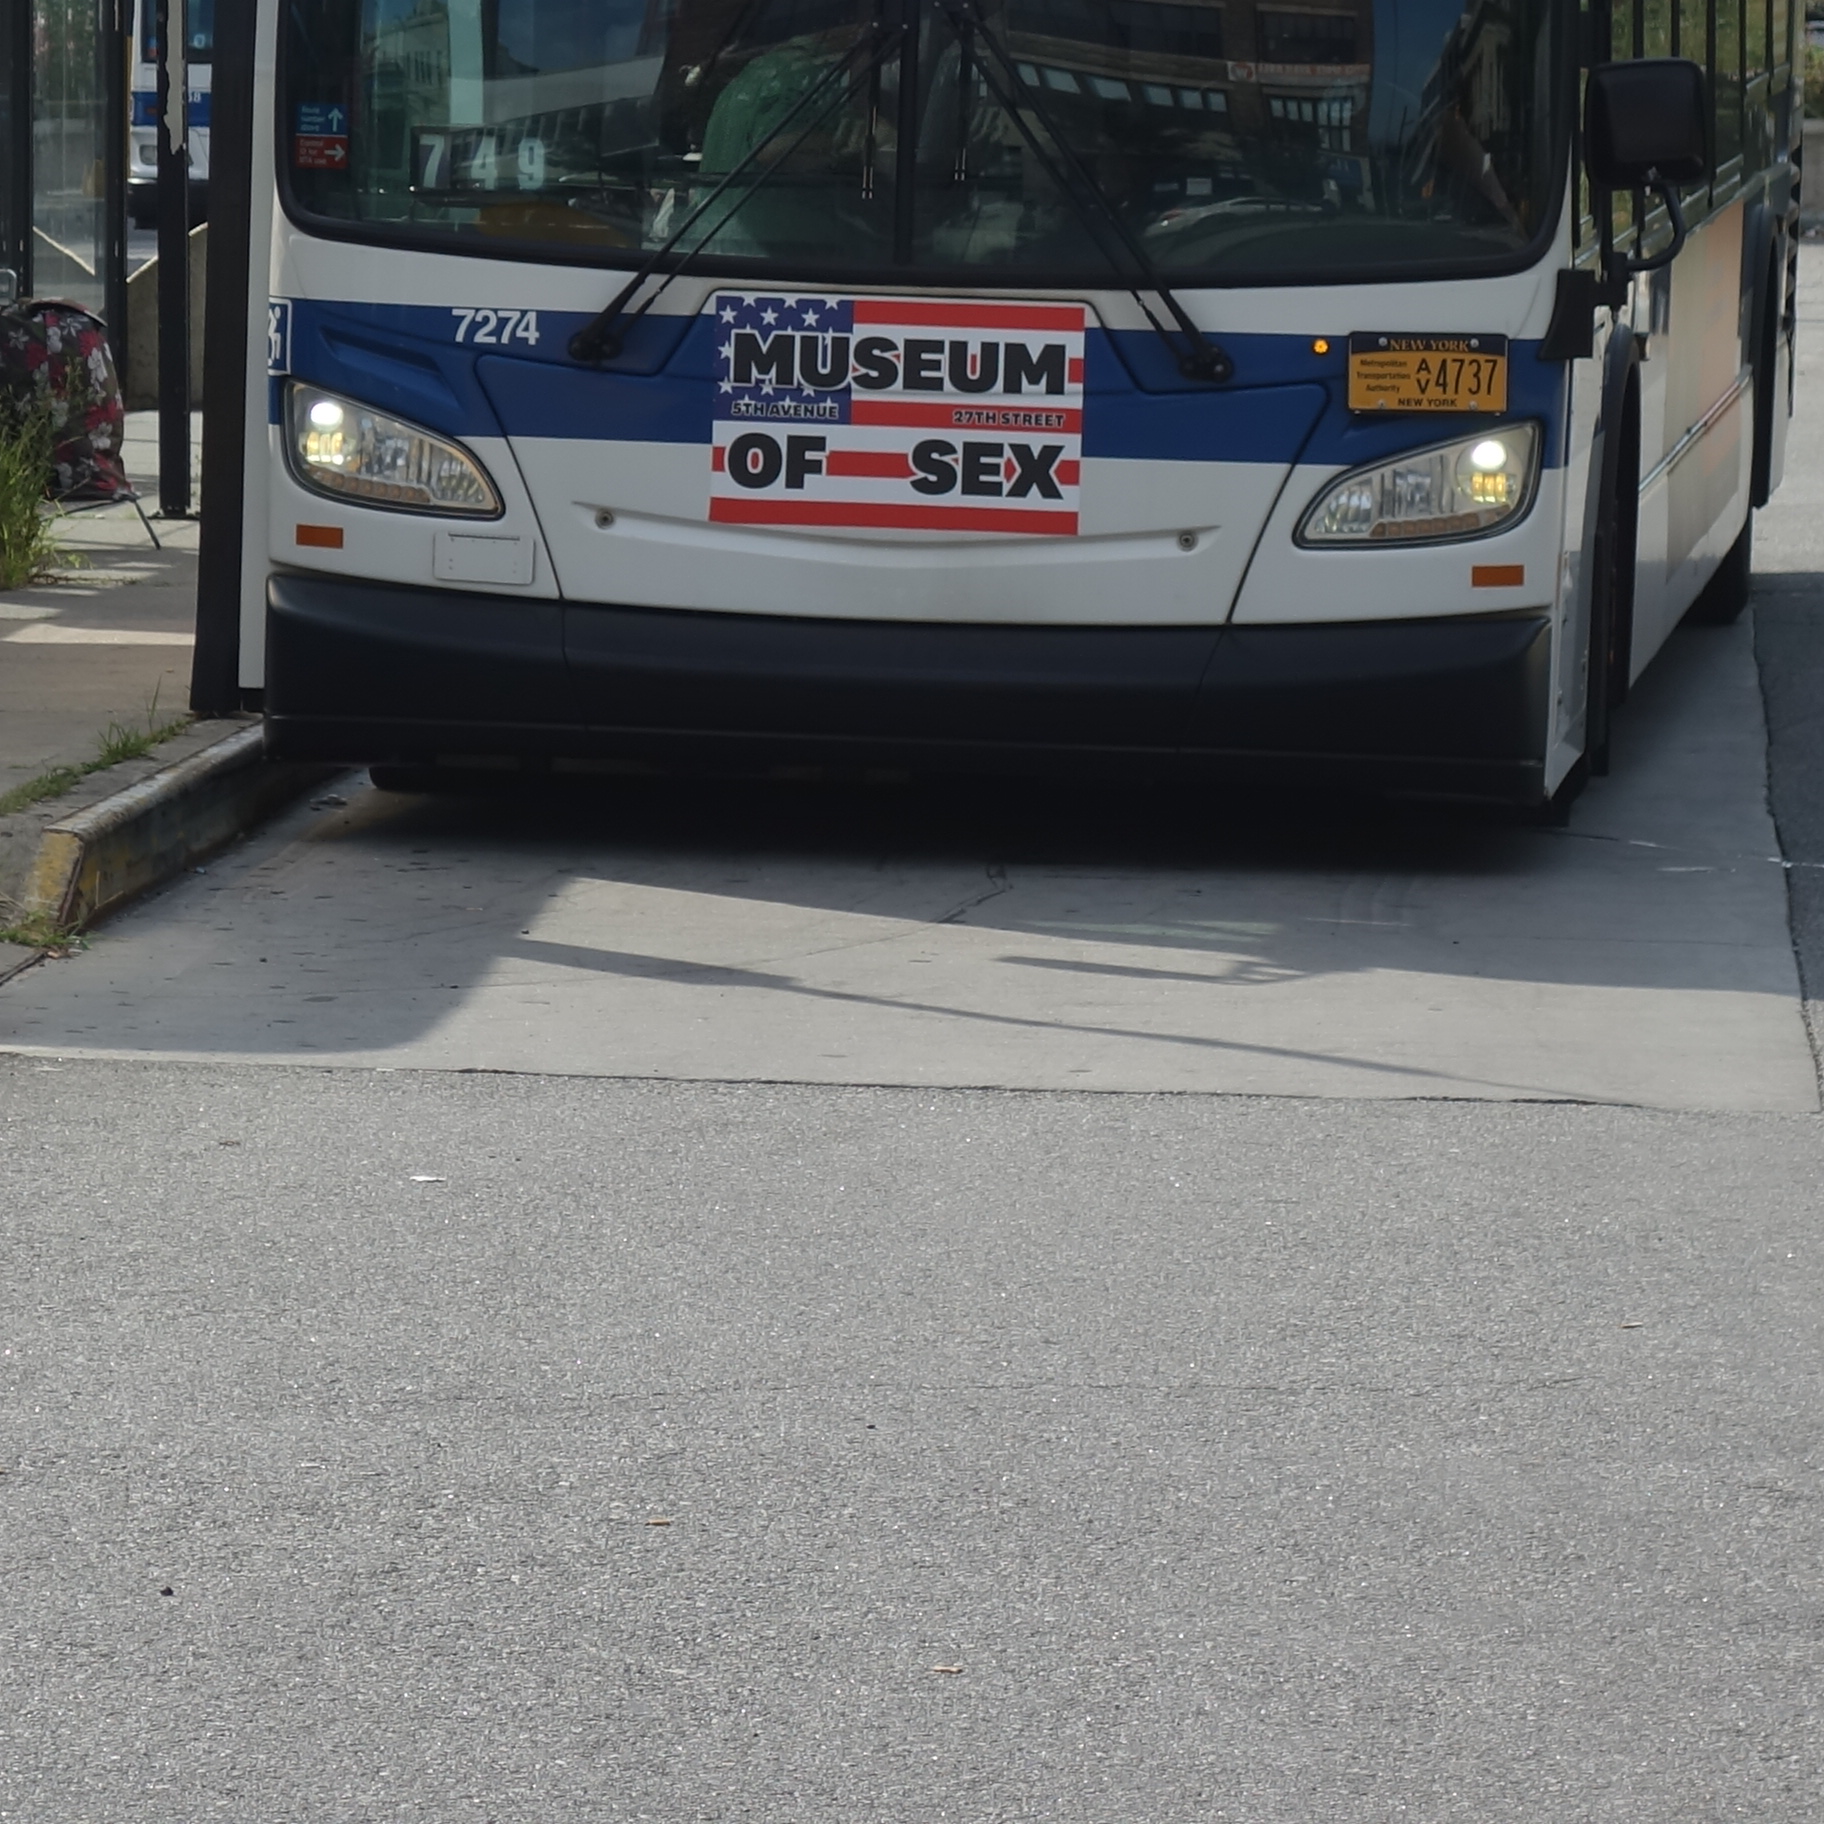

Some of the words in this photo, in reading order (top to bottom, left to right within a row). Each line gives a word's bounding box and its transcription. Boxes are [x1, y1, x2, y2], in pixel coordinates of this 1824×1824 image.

[451, 308, 540, 345] 7274
[730, 331, 1067, 397] MUSEUM
[1389, 338, 1427, 352] NEW
[1430, 338, 1469, 353] YORK
[1434, 358, 1498, 396] 4737
[730, 401, 767, 417] 5TH
[768, 402, 839, 419] AVENUE
[953, 409, 997, 426] 27TH
[998, 411, 1066, 429] STREET
[1397, 398, 1424, 407] NEW
[1426, 398, 1457, 407] YORK
[727, 432, 828, 490] OF
[909, 438, 1066, 501] SEX
